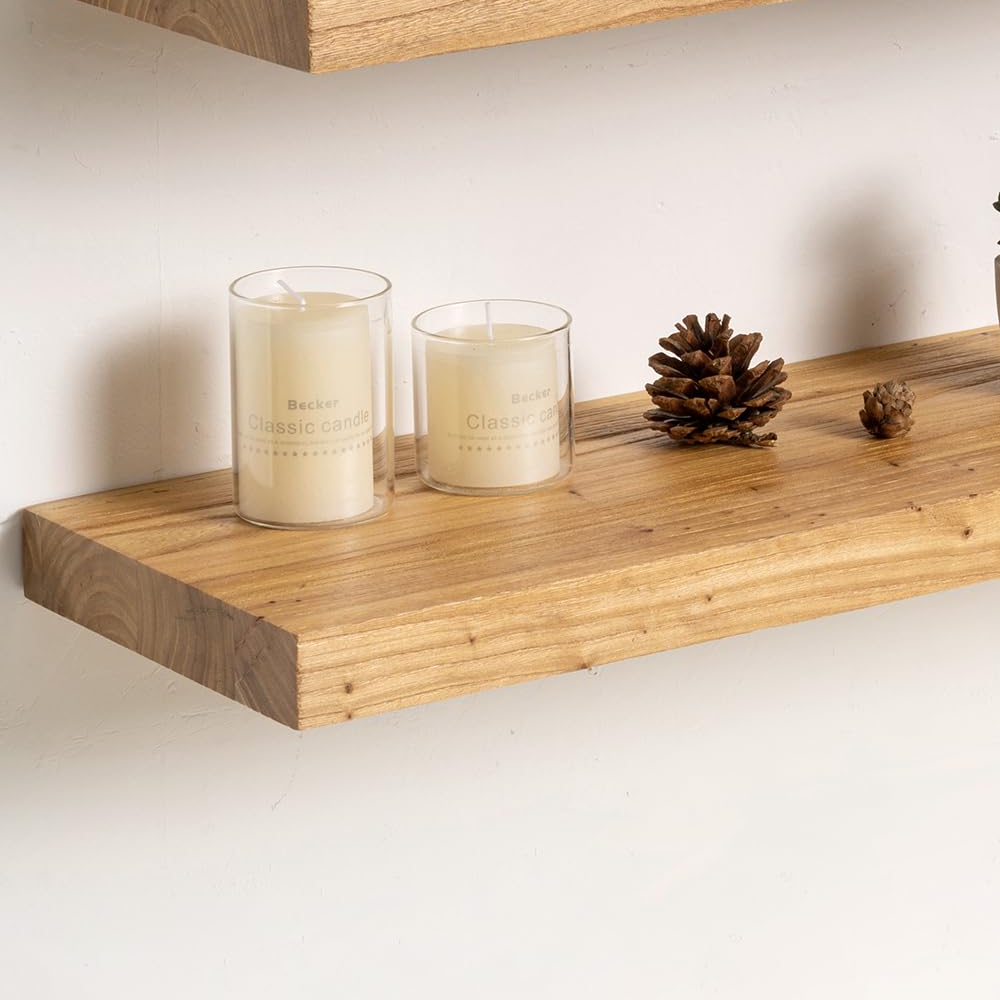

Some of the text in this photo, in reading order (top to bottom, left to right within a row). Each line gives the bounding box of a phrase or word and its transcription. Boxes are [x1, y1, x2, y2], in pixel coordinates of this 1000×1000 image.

[287, 399, 340, 411] Becker
[511, 387, 551, 405] Becker
[248, 408, 370, 435] Classic candle
[465, 413, 536, 431] Classic
